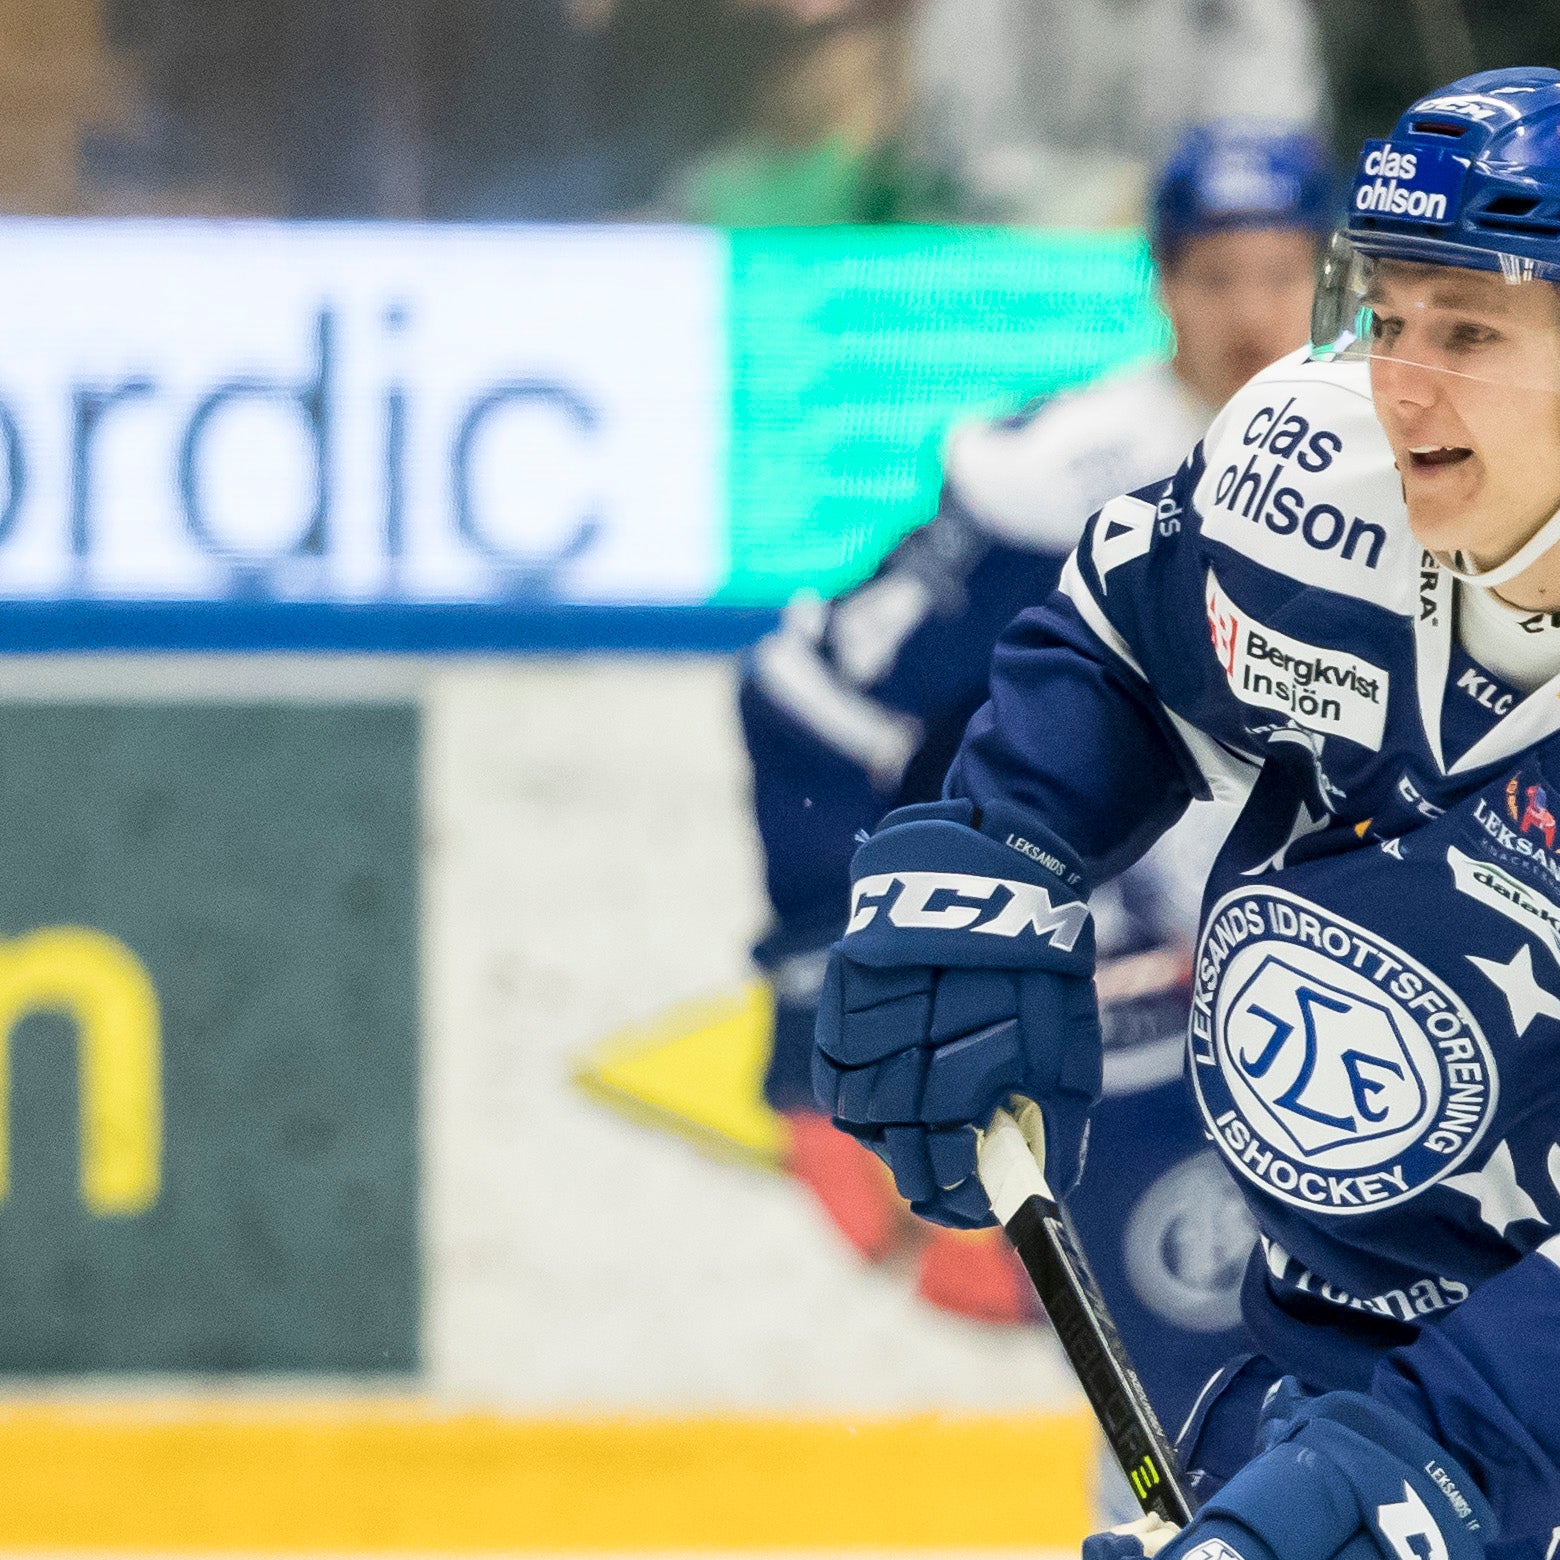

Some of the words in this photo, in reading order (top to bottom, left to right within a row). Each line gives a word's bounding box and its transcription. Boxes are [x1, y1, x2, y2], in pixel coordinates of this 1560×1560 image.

[1356, 180, 1448, 220] ohlson
[1364, 144, 1417, 180] clas
[1242, 397, 1343, 474] clas
[1213, 458, 1388, 570] ohlson
[1242, 663, 1341, 722] Insjön
[1246, 630, 1381, 706] Bergkvist
[1006, 833, 1067, 876] LEKSANDS
[1194, 899, 1264, 1067] LEKSANDS
[1268, 902, 1484, 1156] IDROTTSFÖRENING
[1216, 1109, 1410, 1206] ISHOCKEY
